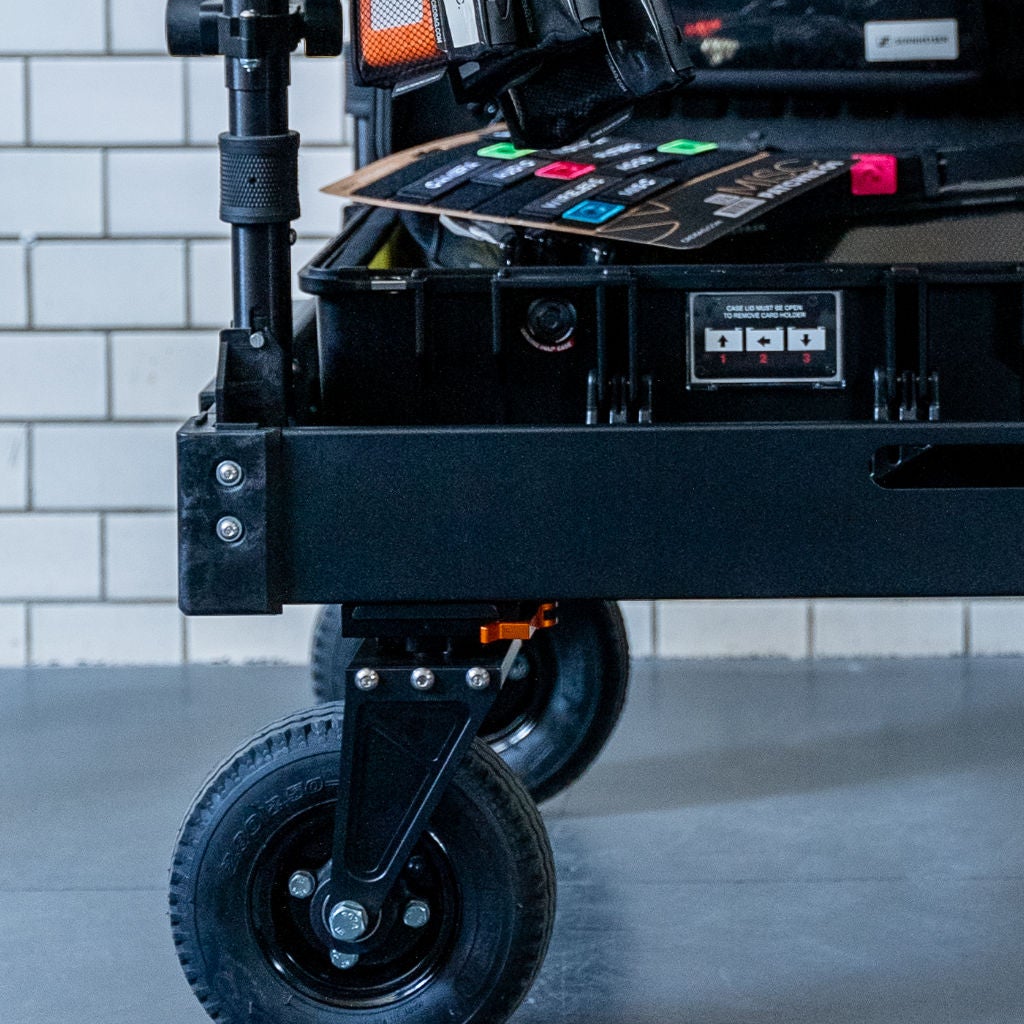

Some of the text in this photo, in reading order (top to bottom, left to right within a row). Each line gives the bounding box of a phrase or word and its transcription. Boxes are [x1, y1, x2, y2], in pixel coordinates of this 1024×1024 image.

[720, 353, 811, 364] 1 2 3
